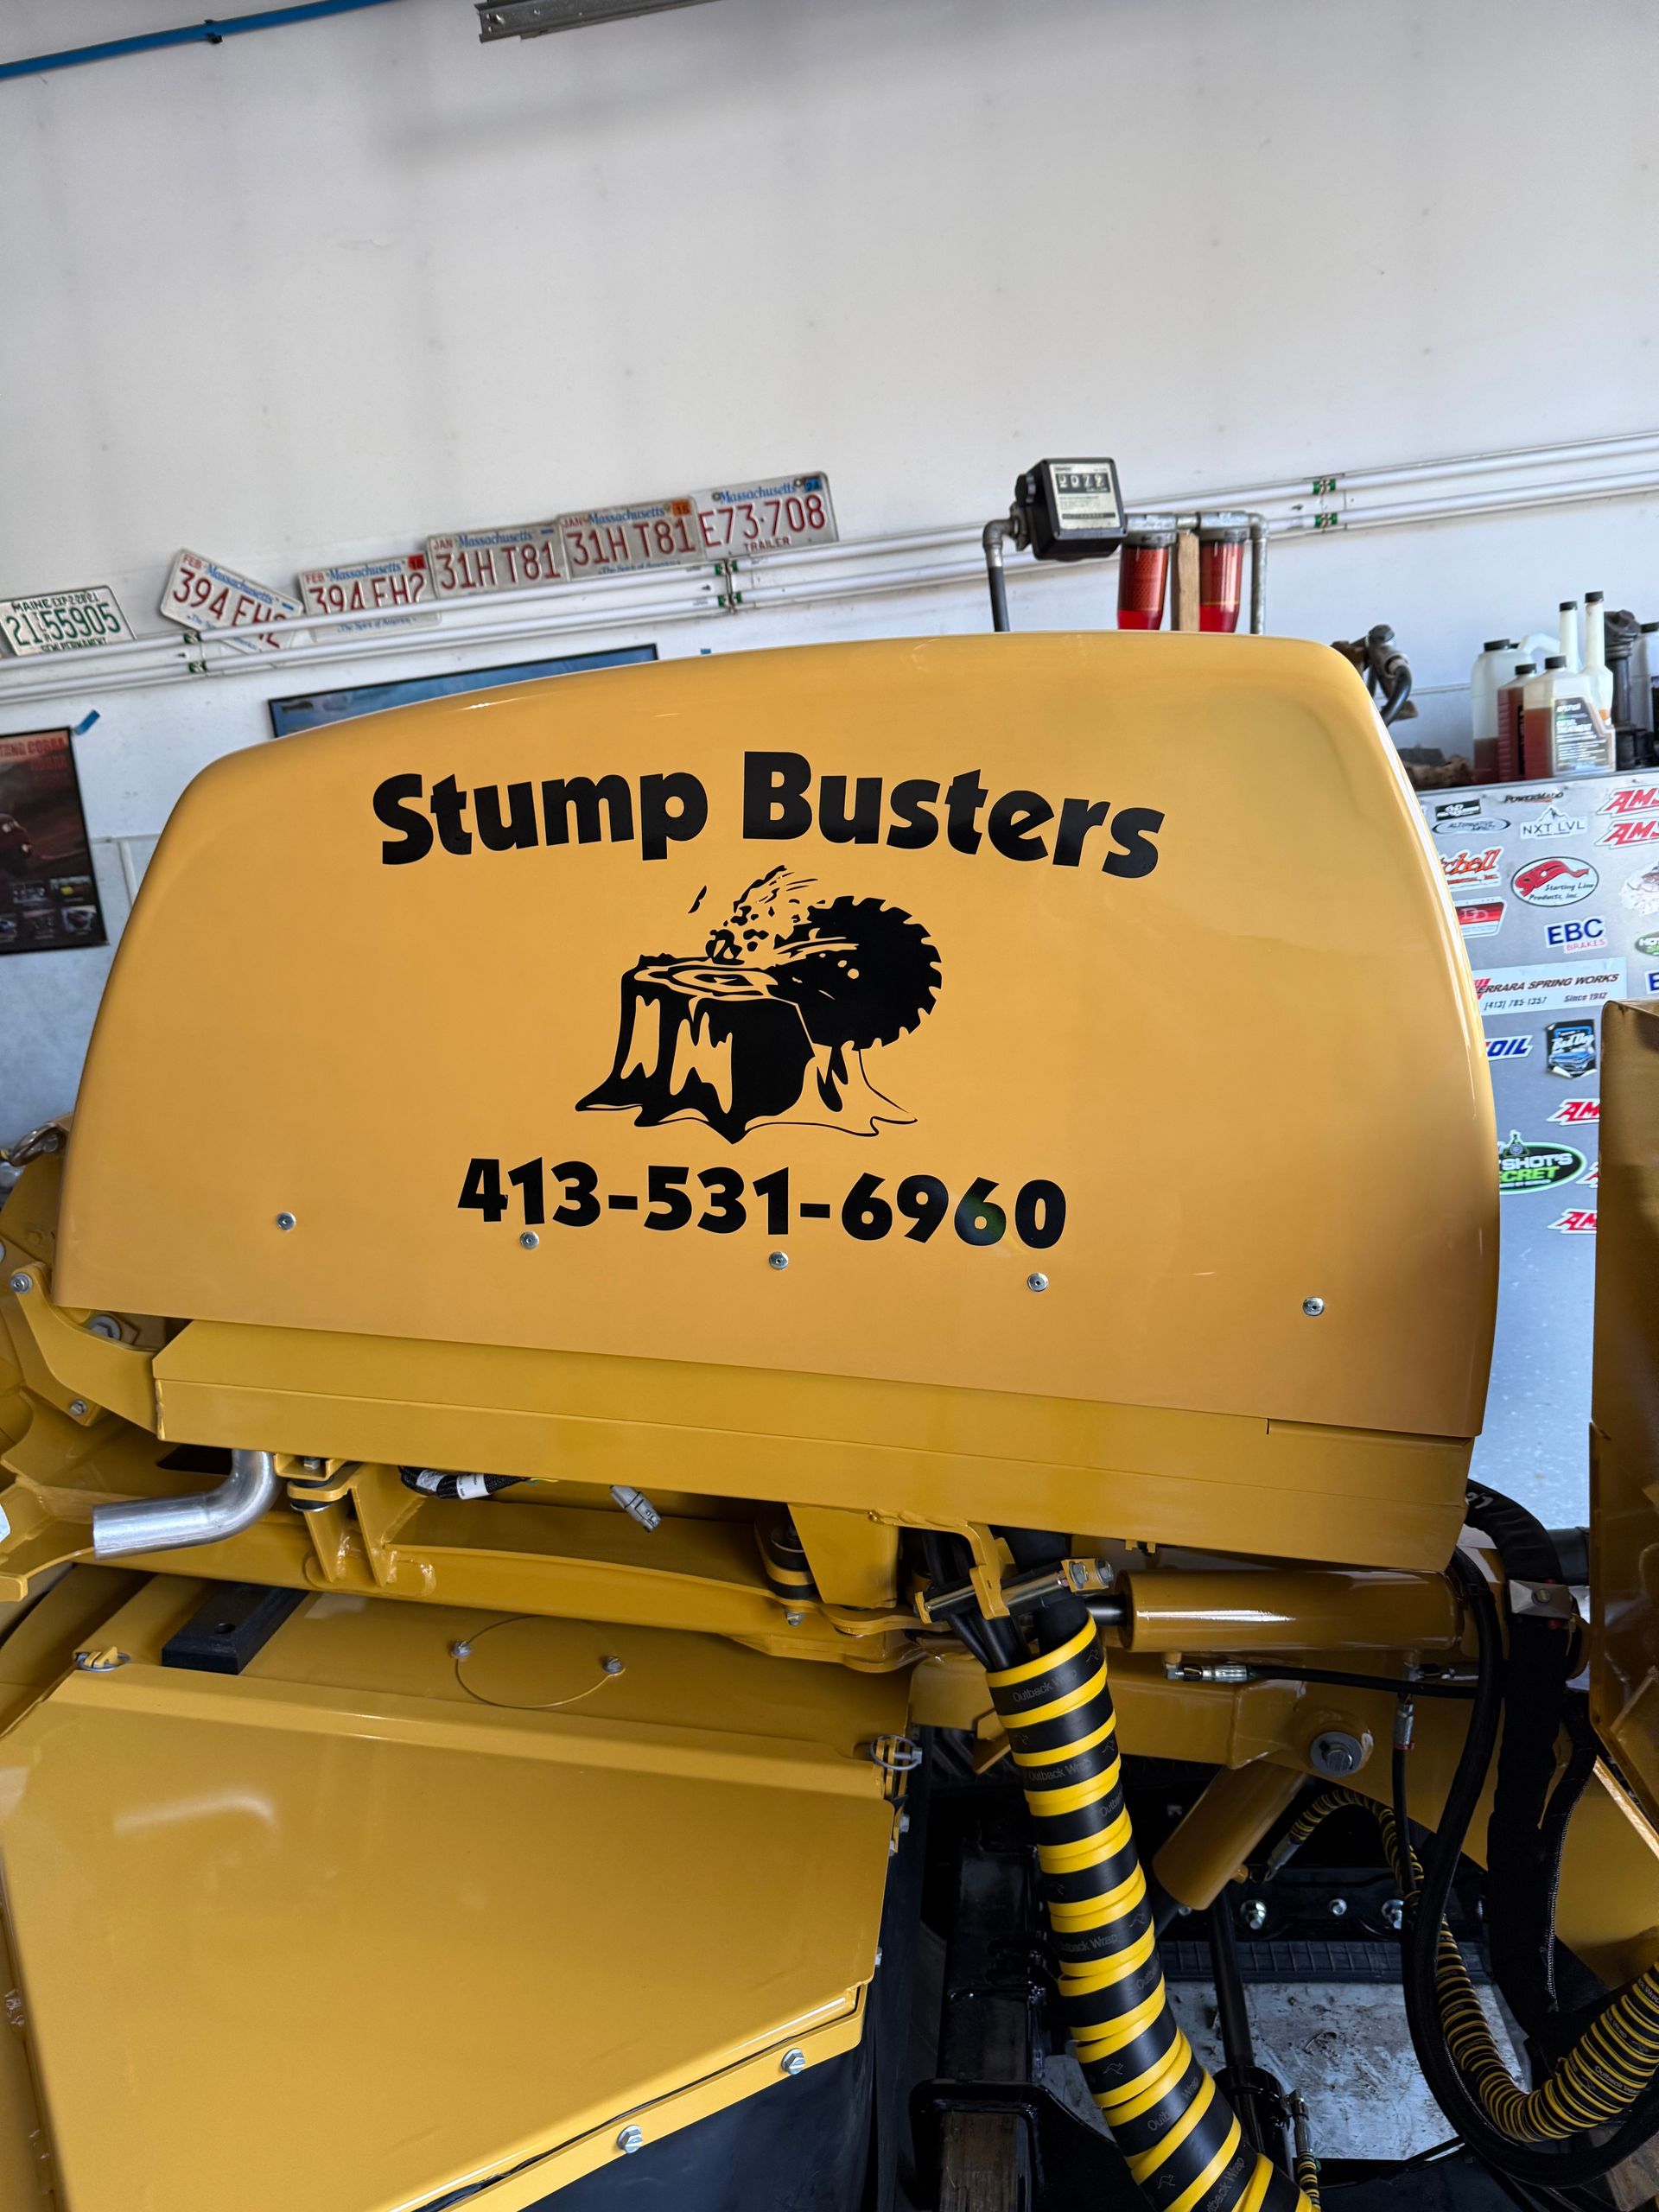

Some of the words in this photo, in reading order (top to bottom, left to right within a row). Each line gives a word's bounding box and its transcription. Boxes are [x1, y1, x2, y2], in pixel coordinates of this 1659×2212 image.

[720, 483, 796, 503] Massachusetts
[588, 505, 664, 524] Massachusetts
[434, 538, 453, 550] JAN
[458, 531, 532, 548] Massachusetts
[566, 525, 629, 566] 31H
[632, 518, 696, 557] T81
[743, 537, 790, 552] TRAILER
[328, 561, 402, 582] Massachusetts
[435, 549, 497, 589] 31H
[500, 540, 561, 583] T81
[207, 562, 273, 605] Massachusetts
[305, 571, 325, 584] FEB
[174, 567, 230, 620] 394
[11, 598, 52, 613] MAINE
[372, 769, 709, 864] Stump
[743, 751, 1166, 879] Busters
[1522, 823, 1552, 836] NXT
[1558, 821, 1585, 832] LVL
[1545, 883, 1576, 892] Starting
[1548, 918, 1604, 945] EBC
[1566, 938, 1606, 951] BRAKES
[1528, 978, 1572, 989] SPRING
[1574, 973, 1620, 985] WORKS
[1564, 994, 1587, 1002] Since
[1485, 1038, 1529, 1058] OIL
[1502, 1152, 1573, 1171] SHOT'S
[458, 1157, 1067, 1249] 413-531-6960
[1013, 1681, 1053, 1703] Outback
[1090, 1934, 1118, 1950] Wrap
[1224, 2157, 1246, 2183] Wrap
